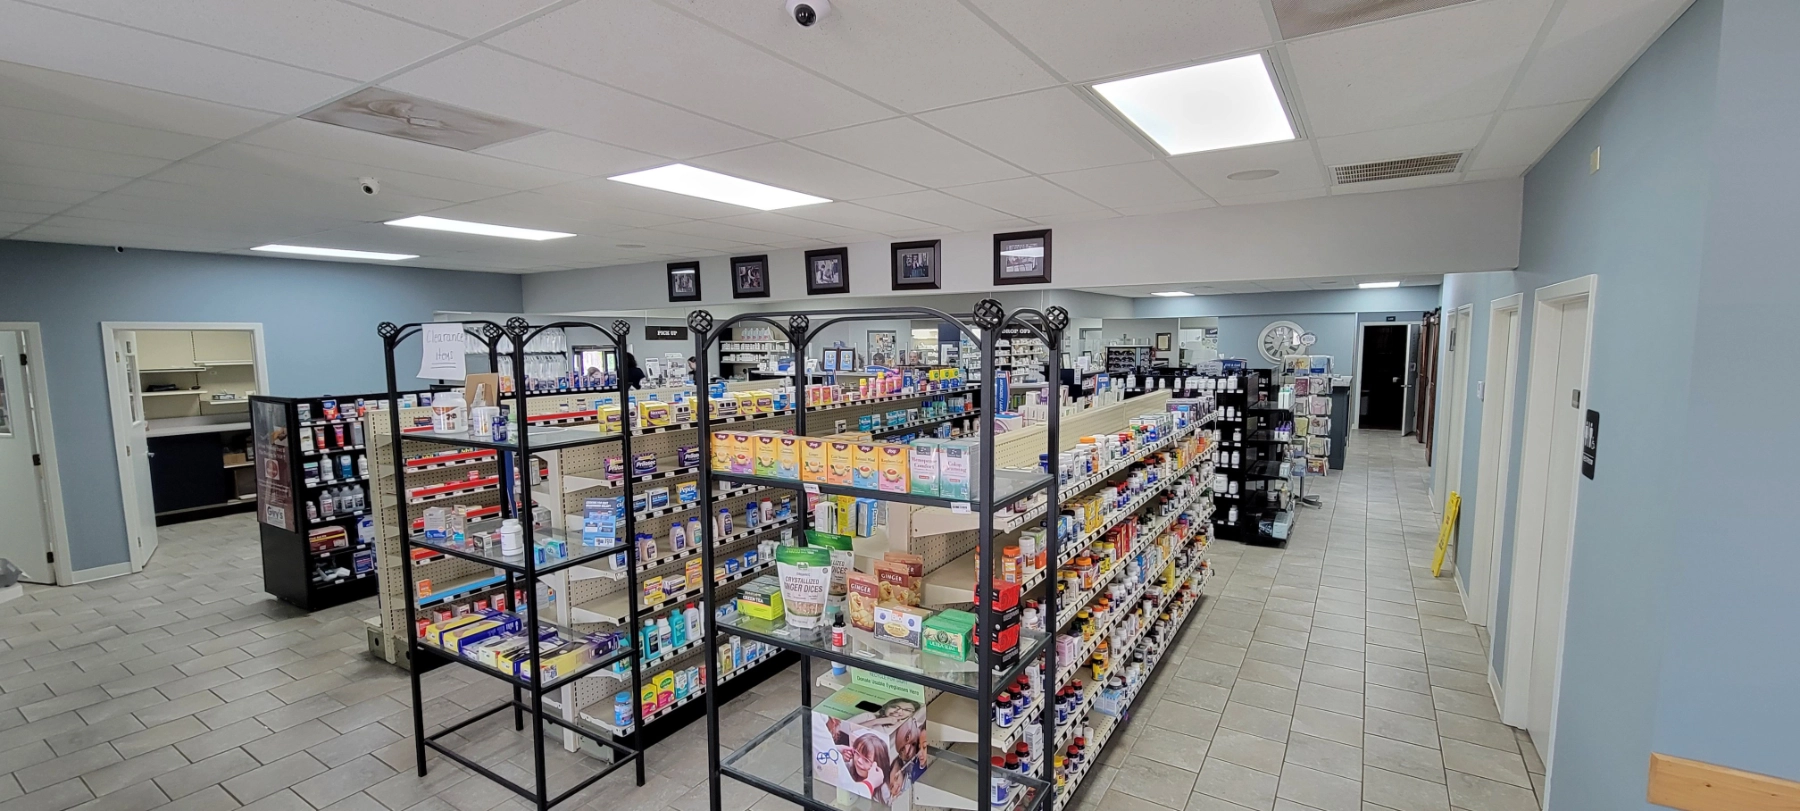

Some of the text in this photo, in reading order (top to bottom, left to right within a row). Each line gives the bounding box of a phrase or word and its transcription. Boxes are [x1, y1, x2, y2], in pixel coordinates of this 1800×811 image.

[426, 330, 464, 344] Clearance
[636, 460, 656, 468] Prilosec
[785, 576, 820, 584] CRYSTALLIZED
[881, 573, 902, 582] GINGER
[804, 584, 823, 593] DICES
[850, 583, 871, 593] GINGER
[872, 679, 885, 687] Usable
[886, 682, 908, 693] Eyeglasses
[909, 688, 920, 696] Here
